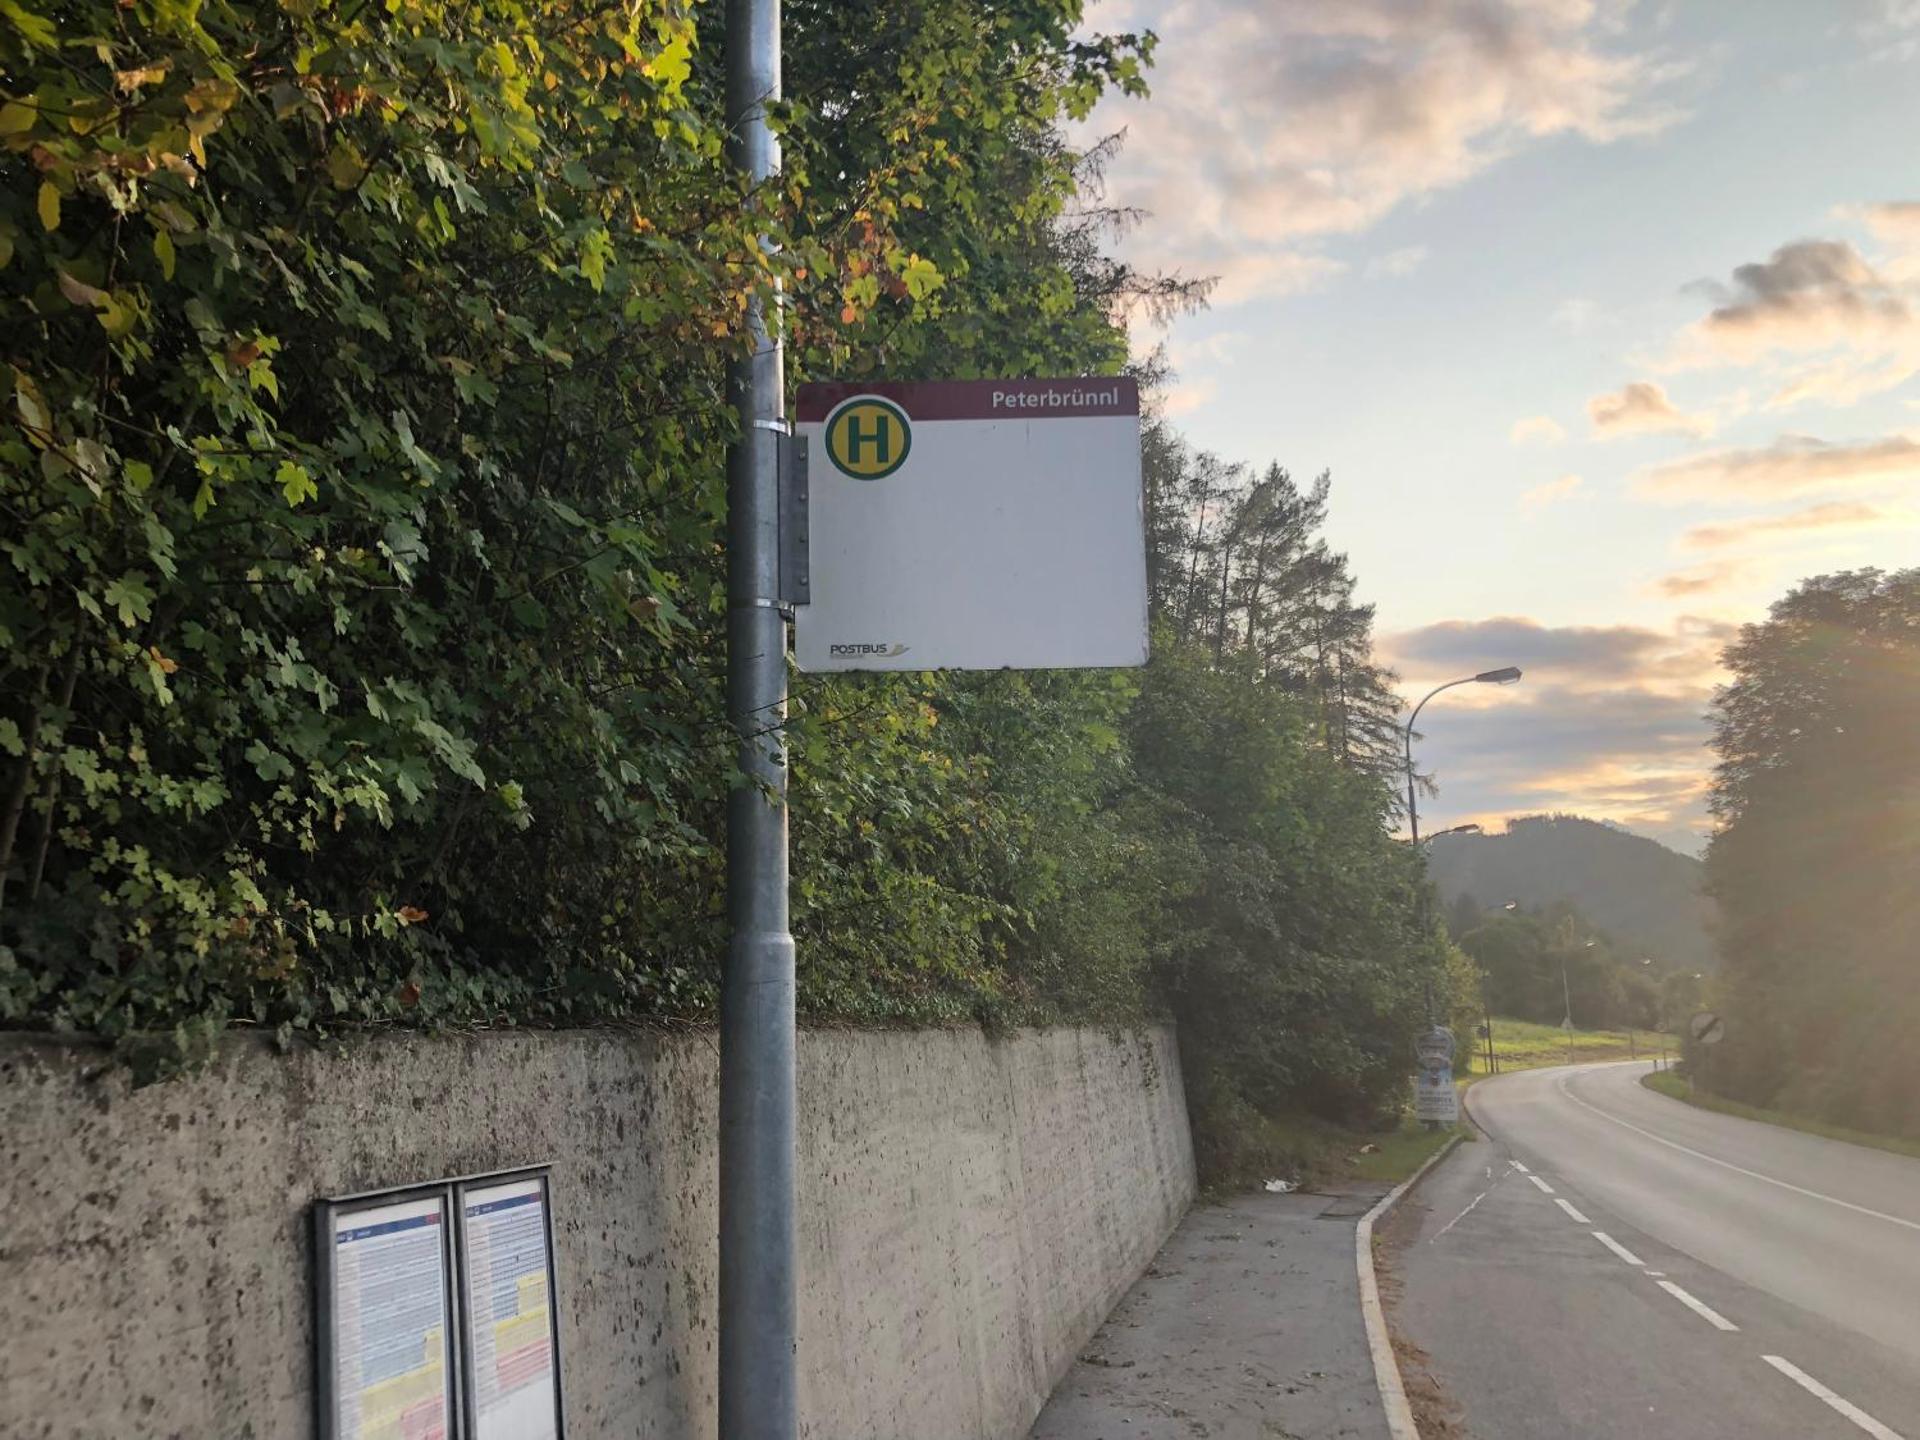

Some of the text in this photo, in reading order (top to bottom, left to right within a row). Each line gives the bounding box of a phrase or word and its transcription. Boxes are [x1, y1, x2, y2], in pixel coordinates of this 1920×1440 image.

[992, 387, 1119, 408] Peterbrünnl
[848, 415, 889, 464] H
[830, 643, 887, 654] POSTBUS
